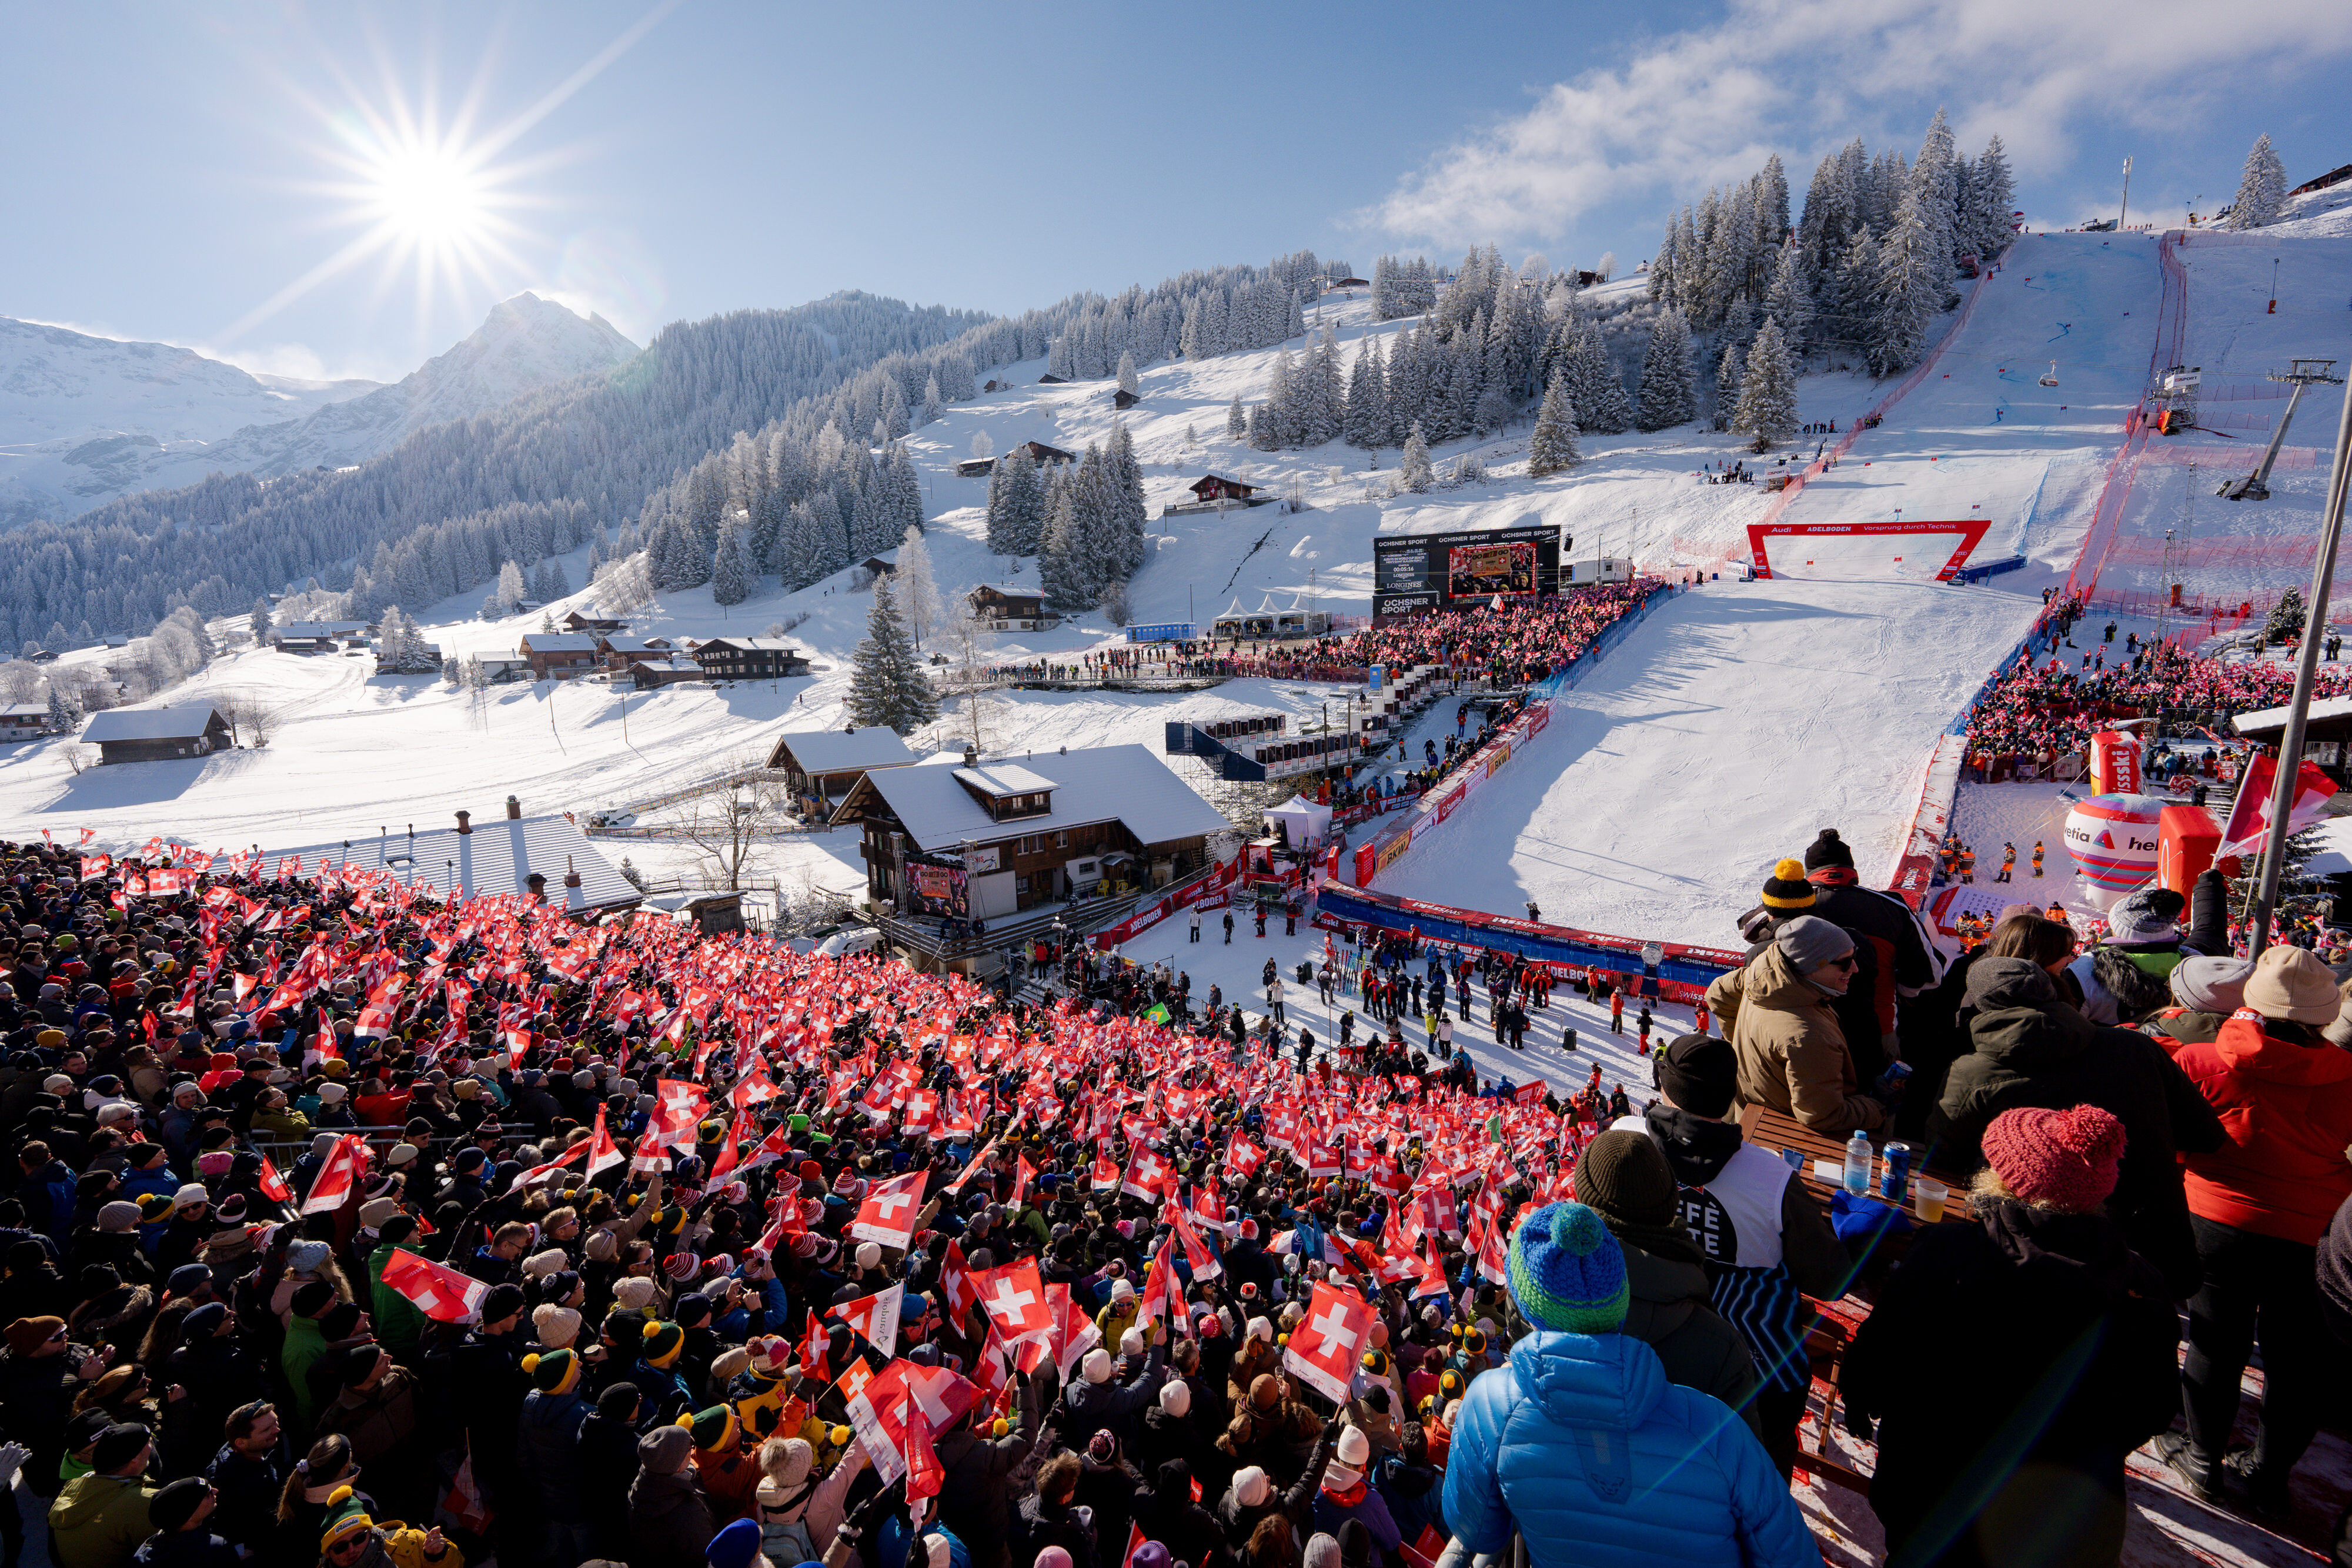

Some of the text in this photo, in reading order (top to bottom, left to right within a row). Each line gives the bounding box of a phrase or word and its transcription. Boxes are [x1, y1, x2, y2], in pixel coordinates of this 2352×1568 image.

[1384, 598, 1428, 607] OCHSNER
[1495, 753, 1507, 770] BKW
[2112, 751, 2130, 793] issski
[1447, 795, 1462, 813] Sunrise
[1387, 841, 1405, 864] BKW
[1332, 891, 1354, 900] OCHSNER
[1375, 902, 1398, 911] OCHSNER
[1130, 907, 1162, 933] ADELBODEN
[1421, 912, 1445, 921] OCHSNER
[1492, 917, 1548, 930] swissski
[1488, 925, 1514, 934] OCHSNER
[1541, 935, 1568, 944] OCHSNER
[1597, 945, 1626, 953] OCHSNER
[1687, 948, 1745, 961] wissski
[1679, 957, 1712, 967] OCHSNER
[336, 1517, 358, 1533] Ricola
